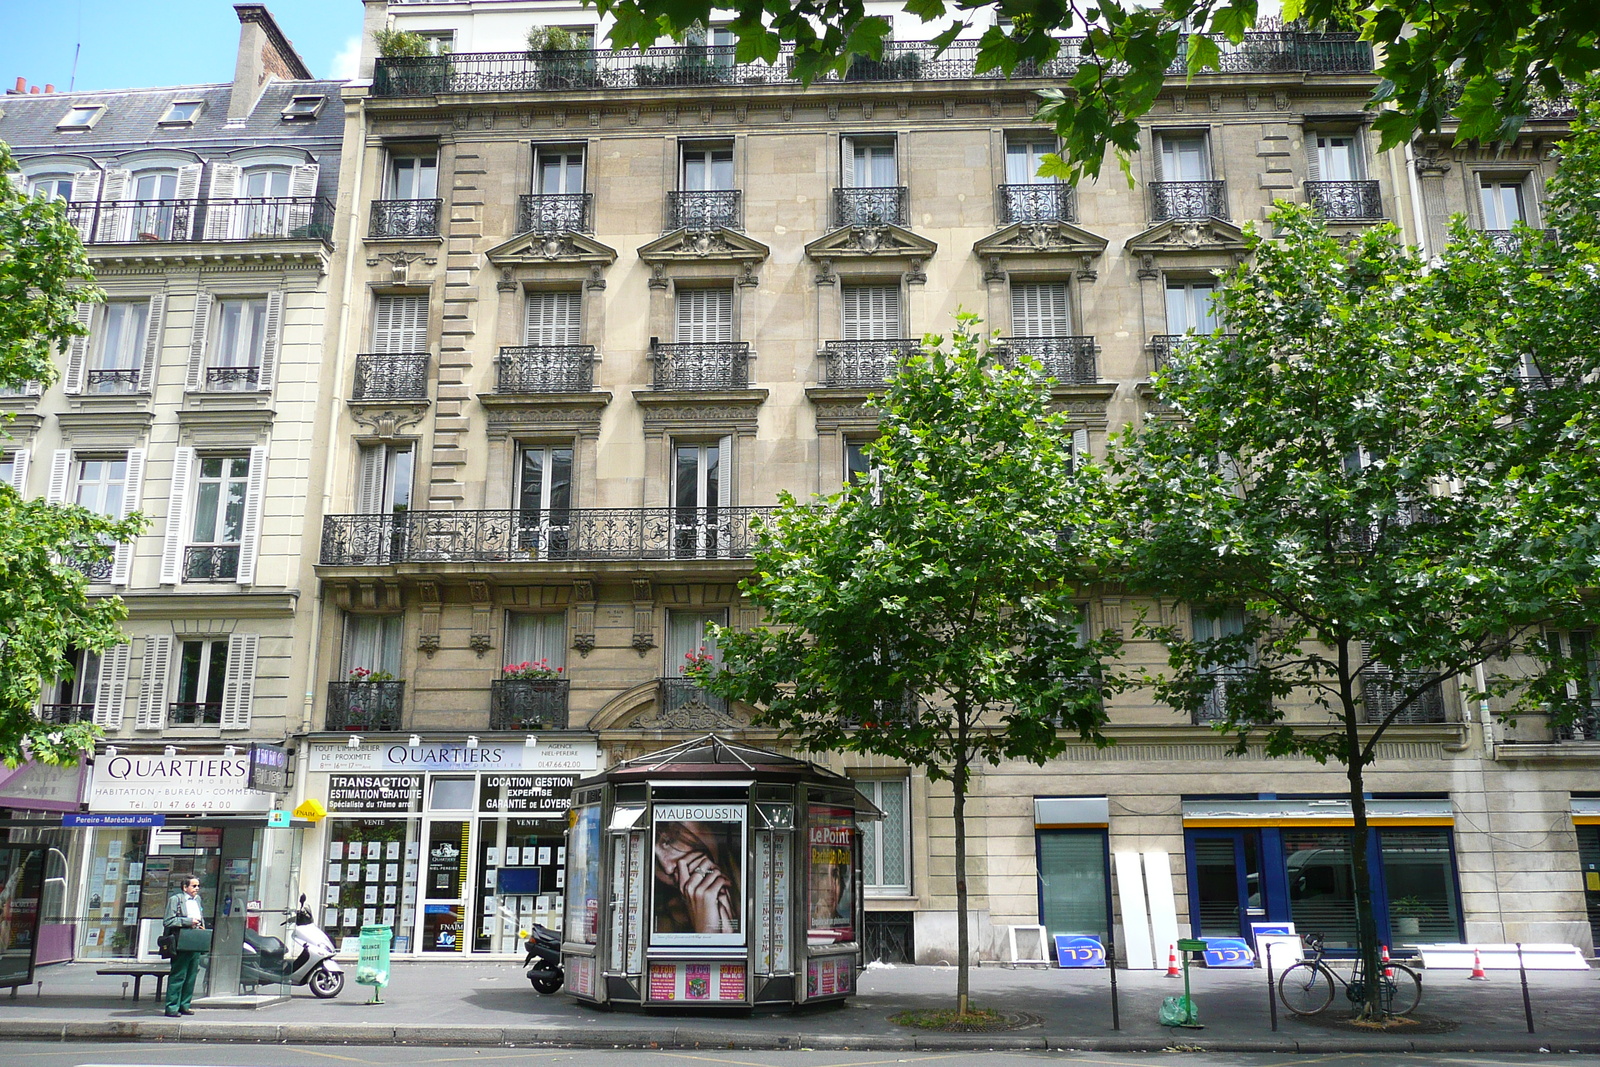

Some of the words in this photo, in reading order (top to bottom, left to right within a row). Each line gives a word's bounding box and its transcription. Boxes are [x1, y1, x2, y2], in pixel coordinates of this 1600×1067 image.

[256, 748, 284, 767] IMMO
[388, 746, 502, 765] QUARTIERS
[108, 757, 246, 780] QUARTIERS
[332, 777, 419, 787] TRANSACTION
[488, 777, 531, 787] LOCATION
[535, 777, 573, 787] GESTION
[330, 790, 379, 799] ESTIMATION
[382, 789, 422, 799] GRATUITE
[329, 800, 365, 809] Spécialiste
[486, 799, 526, 809] GARANTIE
[540, 799, 572, 809] LOYERS
[655, 808, 743, 819] MAUBOUSSIN
[811, 828, 822, 843] Le
[824, 828, 849, 844] Point
[1064, 948, 1103, 960] LCL
[1210, 950, 1250, 961] LCL
